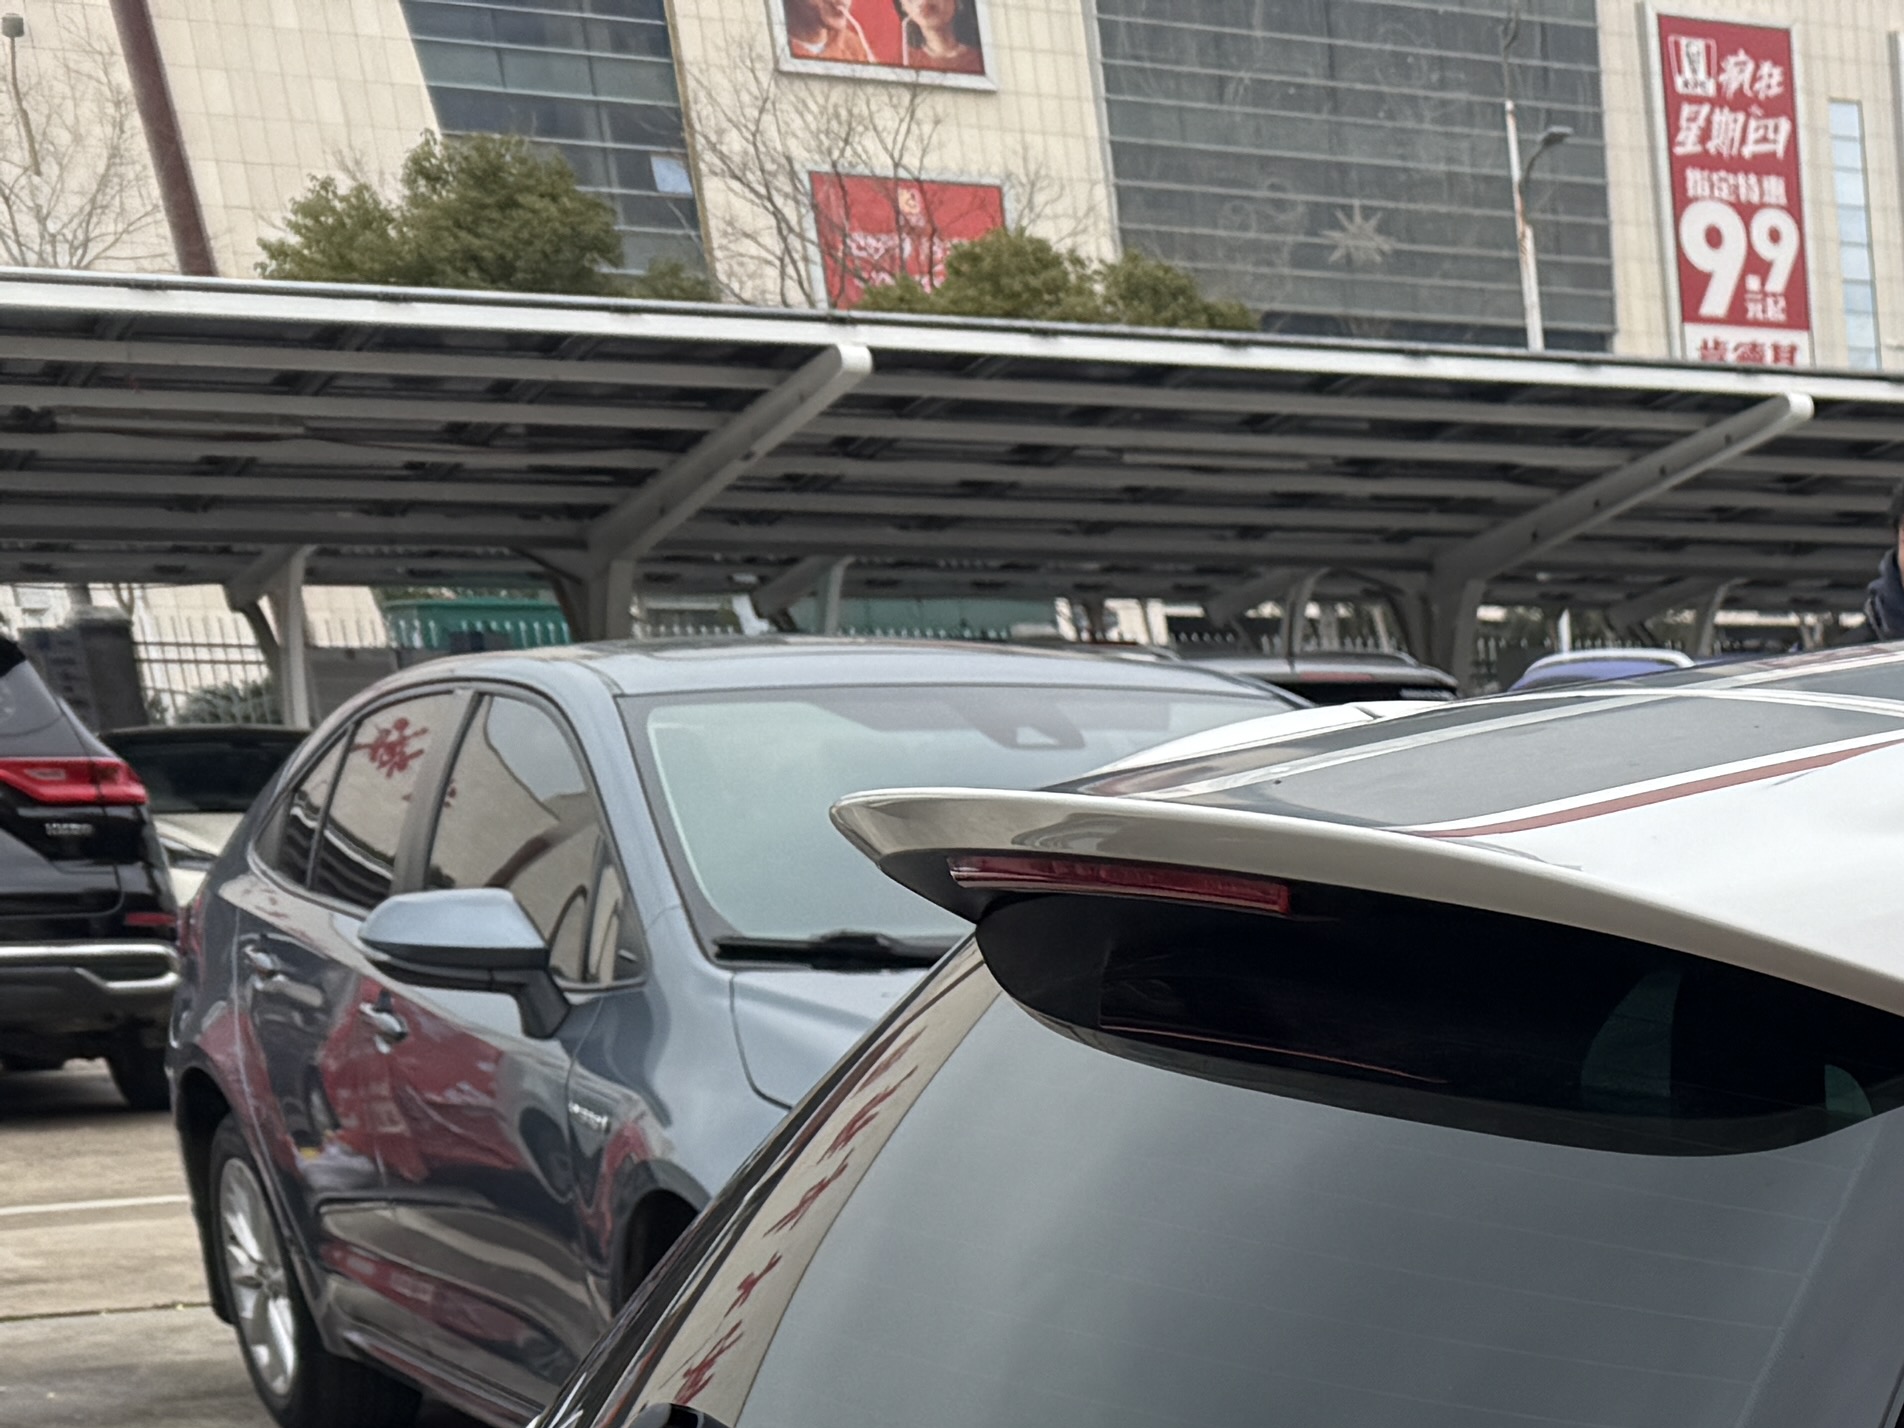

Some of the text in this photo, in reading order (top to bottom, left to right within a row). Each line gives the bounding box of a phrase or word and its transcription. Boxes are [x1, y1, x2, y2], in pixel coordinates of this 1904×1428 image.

[1718, 48, 1784, 99] 疯狂
[1673, 102, 1792, 160] 星期四
[1678, 200, 1800, 318] 9.9
